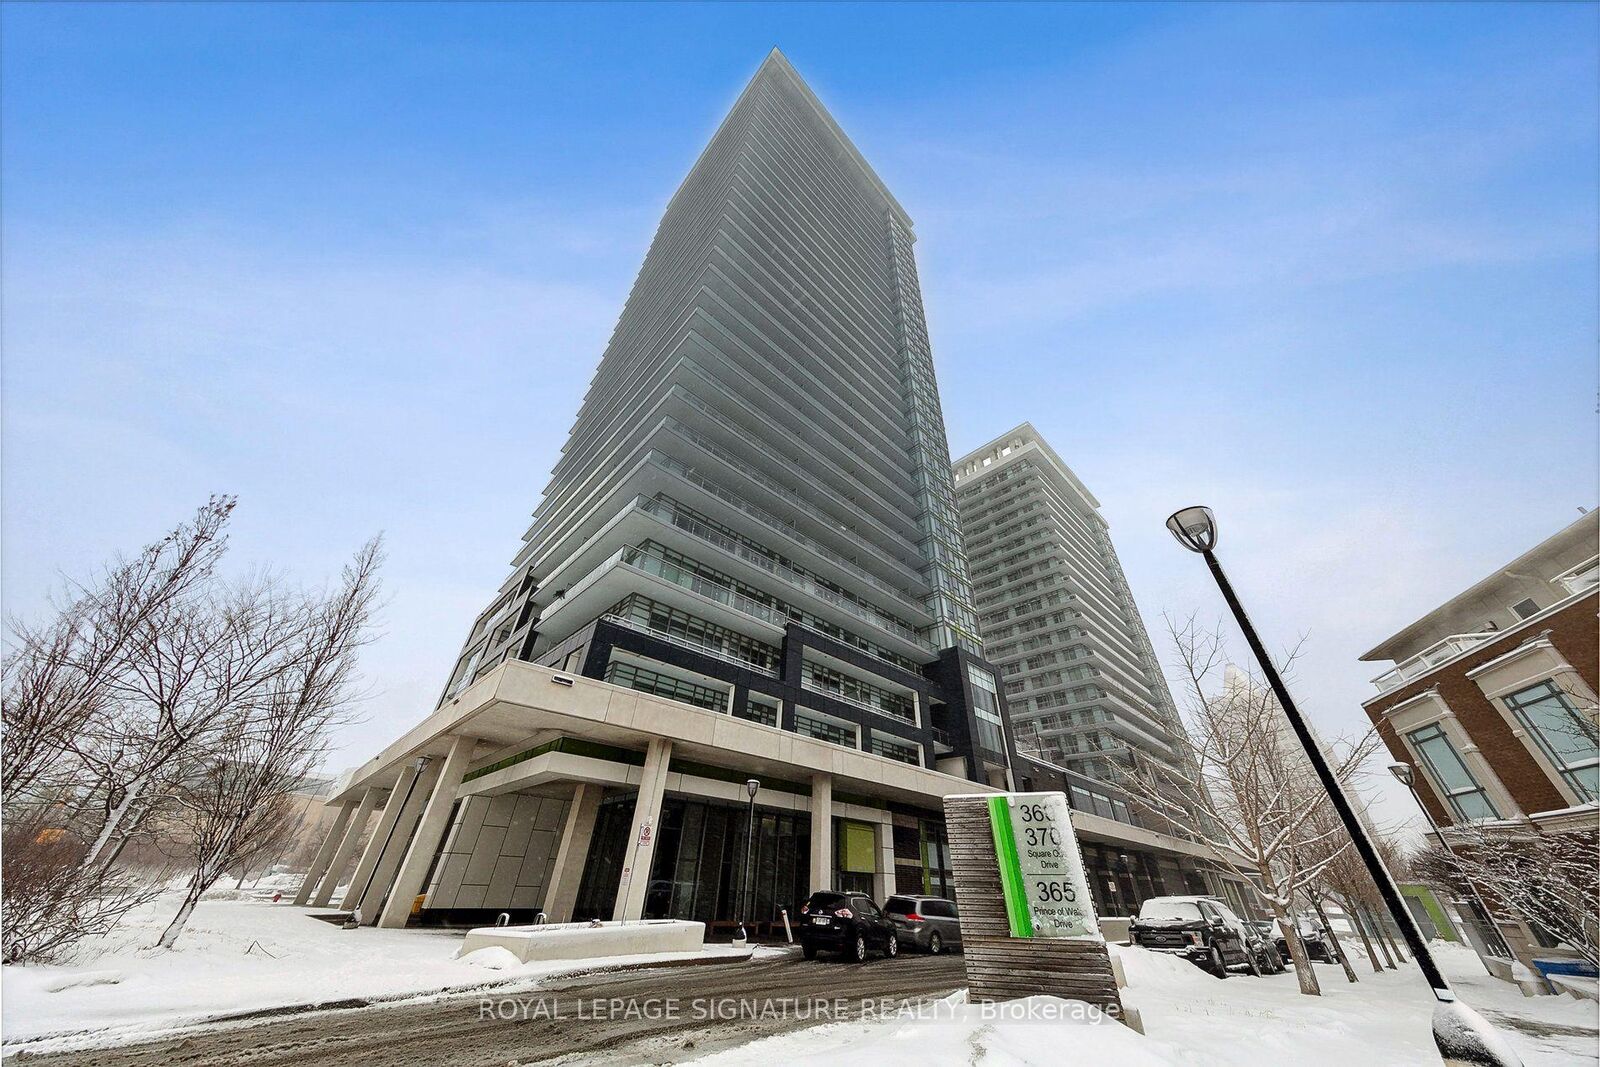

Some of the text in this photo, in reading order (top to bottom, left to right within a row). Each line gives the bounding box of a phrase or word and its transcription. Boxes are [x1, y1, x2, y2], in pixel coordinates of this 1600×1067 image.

[1027, 850, 1052, 859] Square
[1041, 861, 1059, 869] Drive
[1036, 881, 1076, 902] 365
[1033, 906, 1056, 916] Prince
[1057, 907, 1064, 916] of
[1053, 919, 1073, 929] Drive
